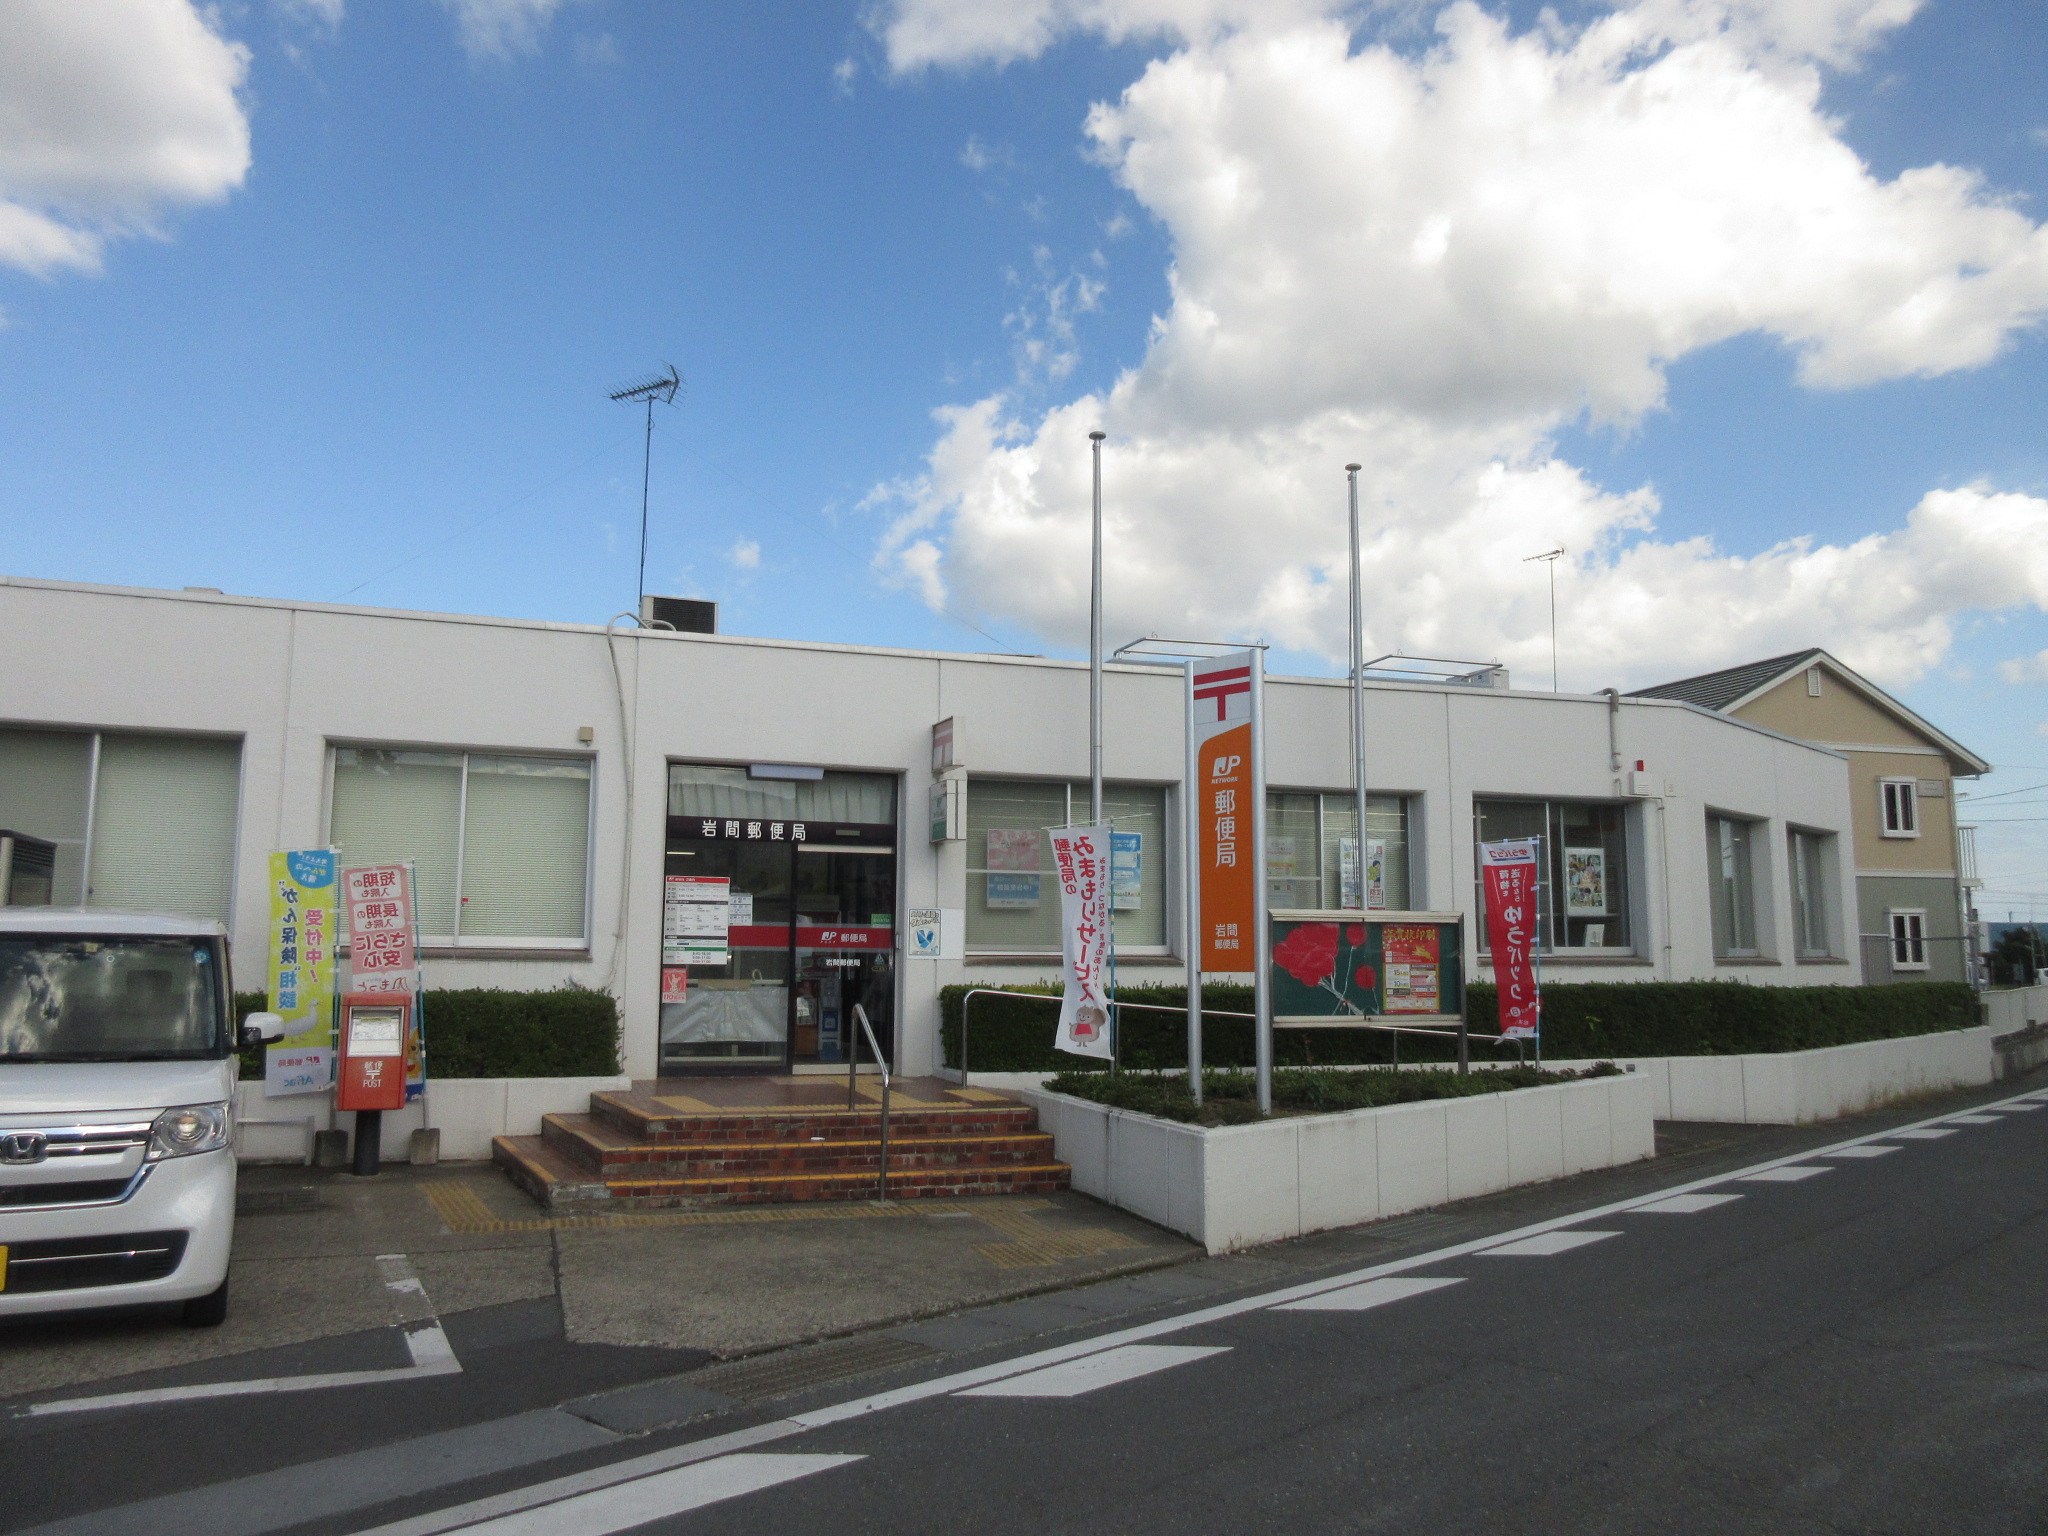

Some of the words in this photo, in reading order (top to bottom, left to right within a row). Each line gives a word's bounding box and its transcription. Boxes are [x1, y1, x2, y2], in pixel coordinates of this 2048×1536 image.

[1211, 776, 1239, 785] NETWORK
[701, 819, 807, 842] 岩間郵便局
[1214, 789, 1236, 868] 郵便局
[1215, 923, 1238, 938] 岩間
[840, 933, 868, 943] 郵便局
[1214, 938, 1240, 950] 郵便局
[363, 1061, 384, 1071] 郵便
[363, 1079, 382, 1088] POST
